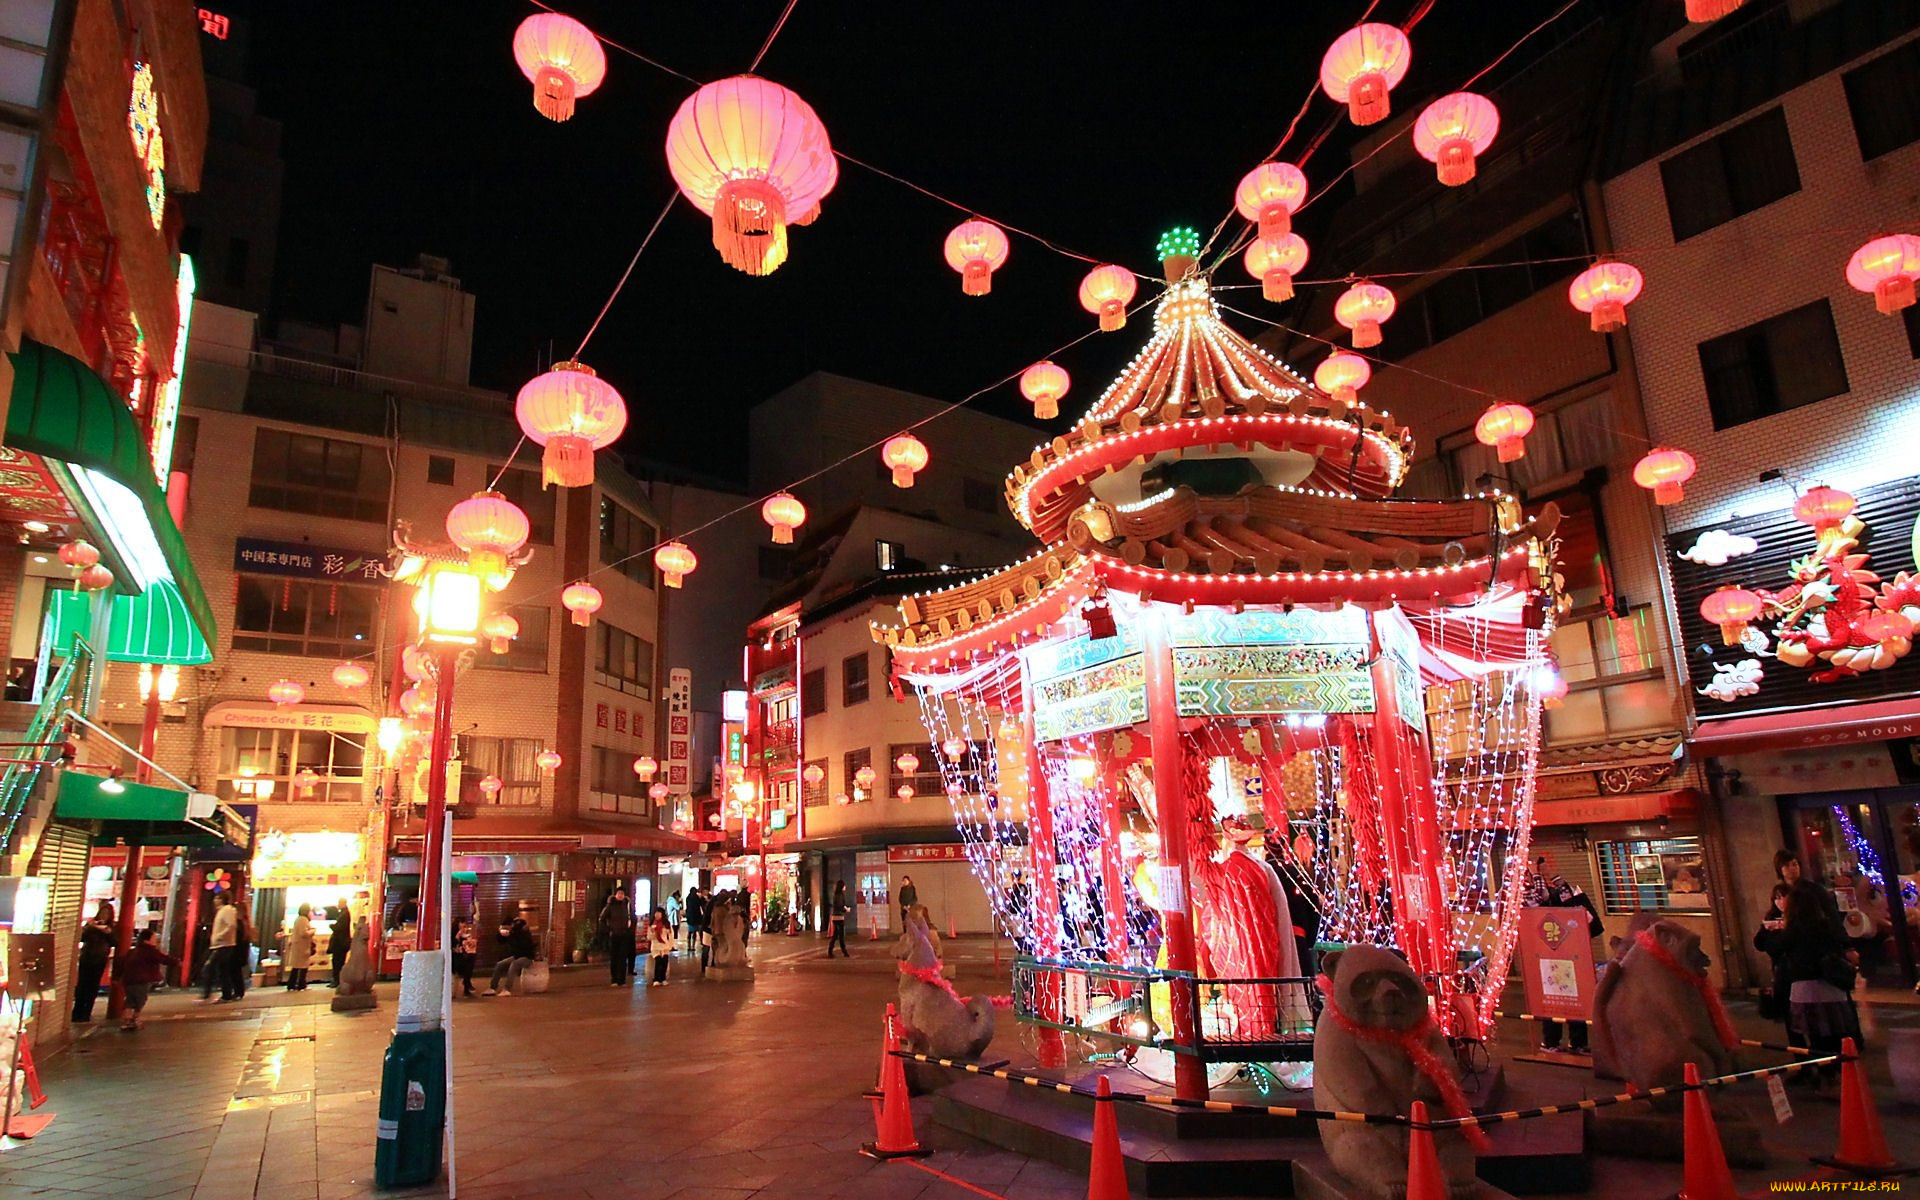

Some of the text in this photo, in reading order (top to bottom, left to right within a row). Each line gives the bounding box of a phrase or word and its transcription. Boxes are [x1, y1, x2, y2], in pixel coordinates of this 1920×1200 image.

[241, 549, 313, 568] 中国茶専門店
[225, 712, 267, 723] Chinese
[271, 715, 297, 725] Cafe
[1857, 724, 1913, 738] MOON
